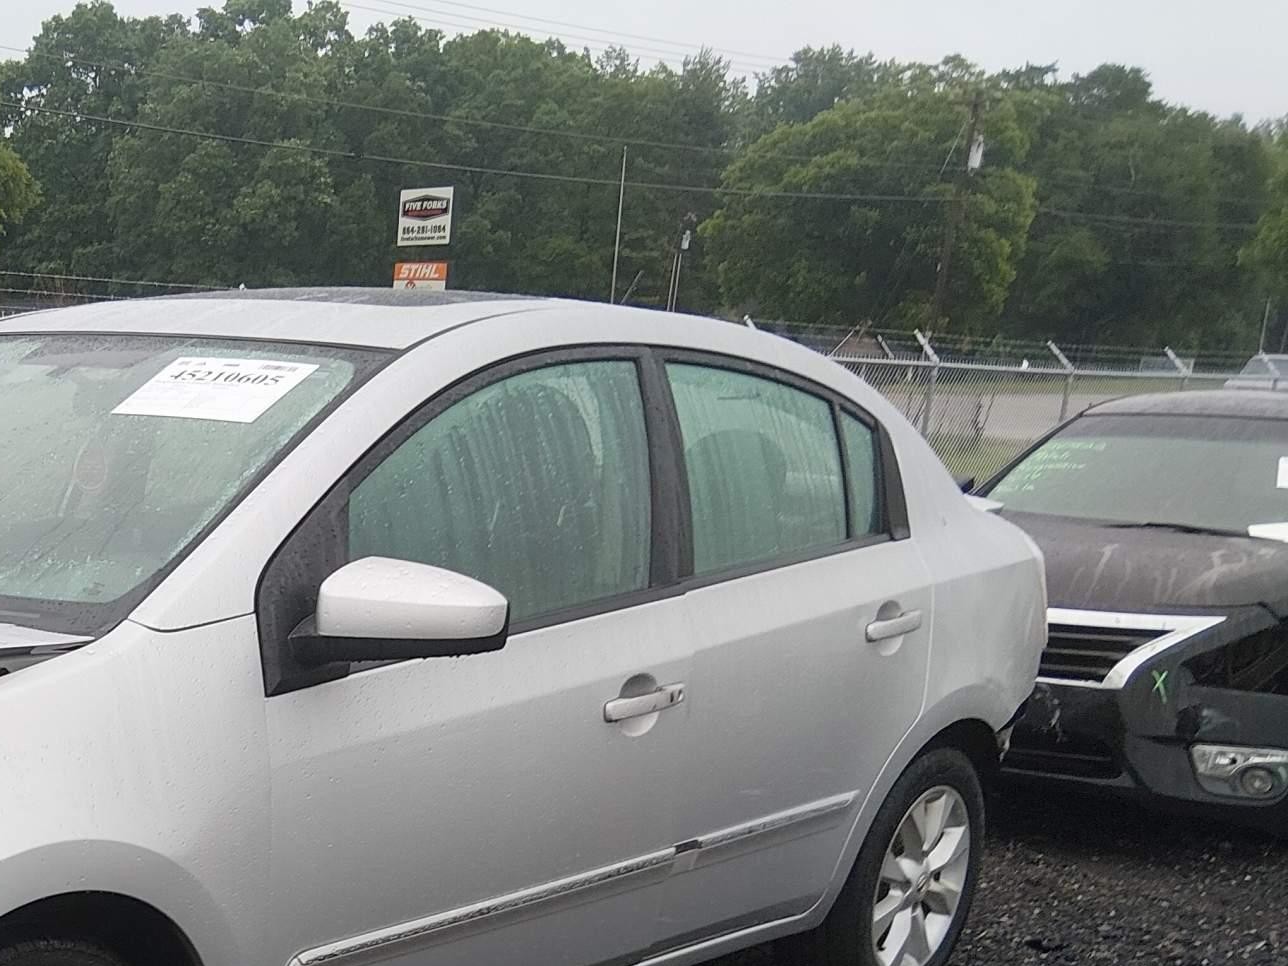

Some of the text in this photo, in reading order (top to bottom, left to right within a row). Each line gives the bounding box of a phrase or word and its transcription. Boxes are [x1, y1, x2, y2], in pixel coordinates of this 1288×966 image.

[405, 199, 447, 211] FIVE FORKS
[399, 263, 439, 278] STIHL
[170, 370, 285, 386] 45210605
